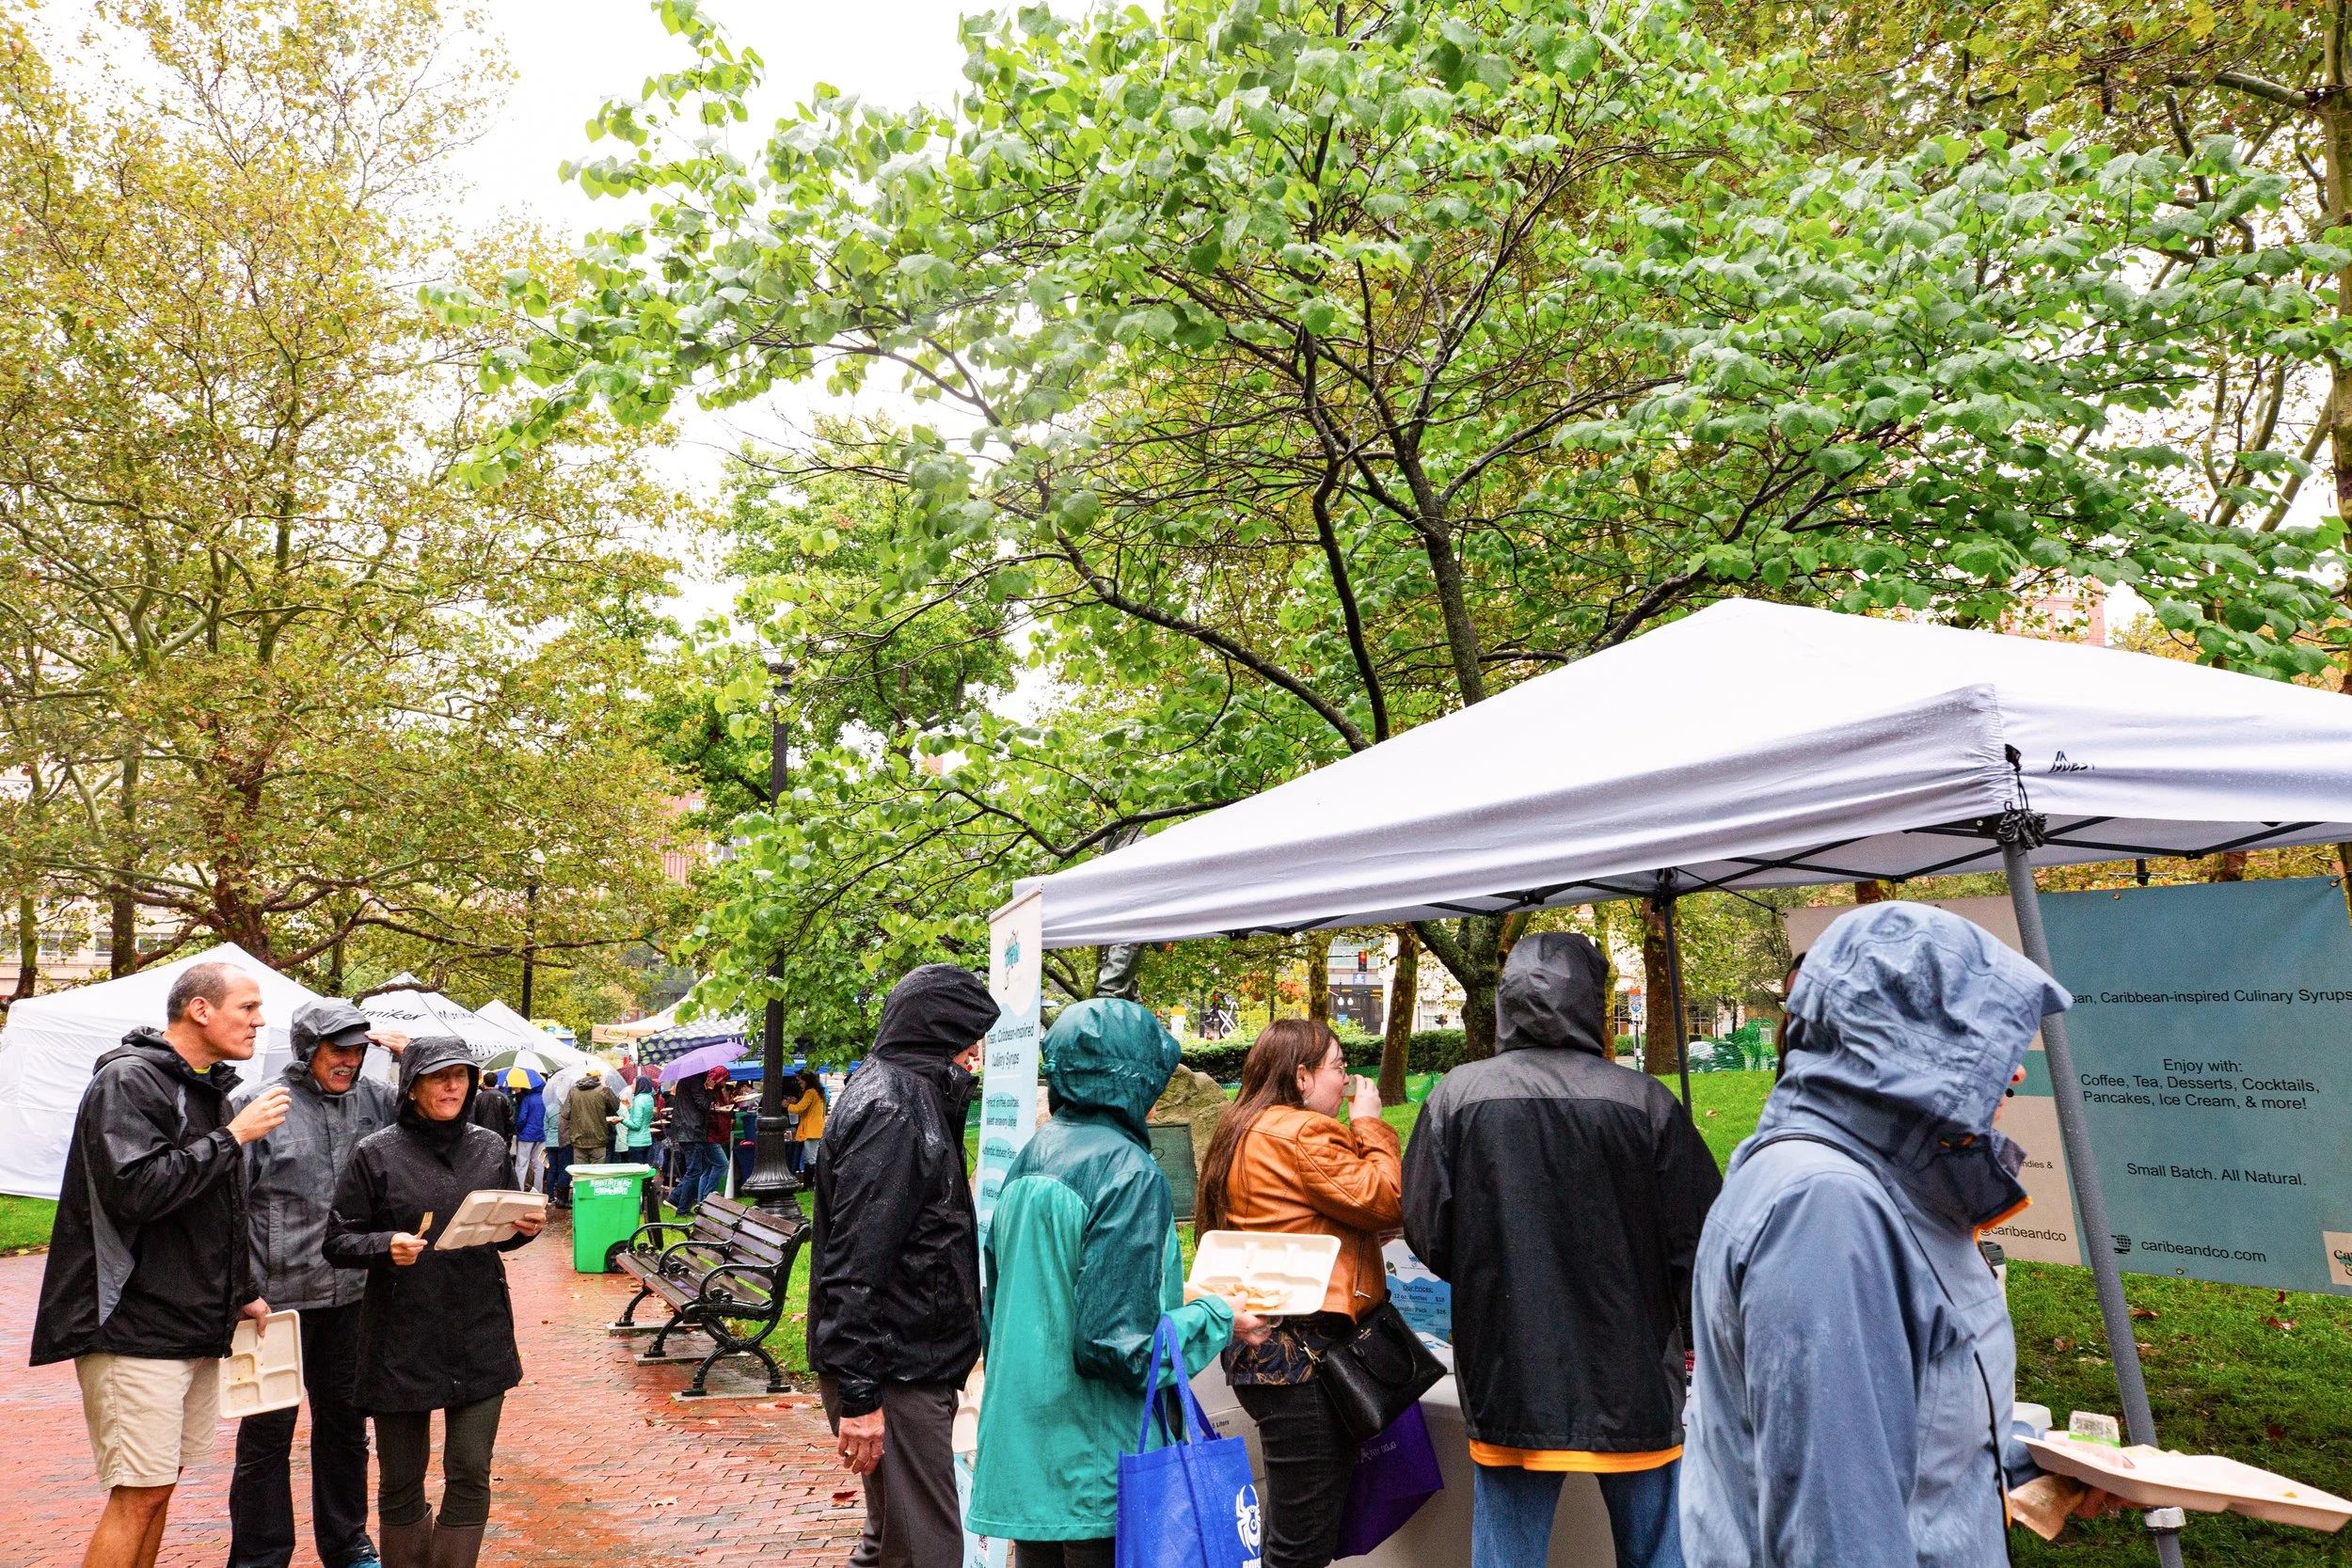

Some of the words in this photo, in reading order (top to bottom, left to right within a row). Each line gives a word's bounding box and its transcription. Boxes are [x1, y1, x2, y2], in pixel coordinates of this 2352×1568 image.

[2073, 993, 2097, 1006] san,
[2100, 990, 2230, 1005] Caribbean-inspired
[2233, 990, 2294, 1005] Culinary
[2298, 989, 2352, 1004] Syrups
[2164, 1058, 2203, 1074] Enjoy
[2207, 1059, 2244, 1072] with:
[2080, 1073, 2130, 1089] Coffee,
[2132, 1075, 2163, 1089] Tea,
[2167, 1076, 2238, 1091] Desserts,
[2242, 1077, 2320, 1094] Cocktails,
[2083, 1090, 2155, 1106] Pancakes,
[2159, 1093, 2181, 1105] Ice
[2185, 1094, 2240, 1109] Cream,
[2245, 1095, 2257, 1108] &
[2261, 1097, 2308, 1110] more!
[2022, 1160, 2044, 1169] ndies
[2046, 1161, 2054, 1169] &
[2126, 1163, 2166, 1177] Small
[2170, 1165, 2217, 1180] Batch.
[2221, 1168, 2240, 1181] All
[2245, 1170, 2307, 1186] Natural.
[2140, 1241, 2267, 1262] caribeandco.com
[1414, 1285, 1434, 1293] Prices:
